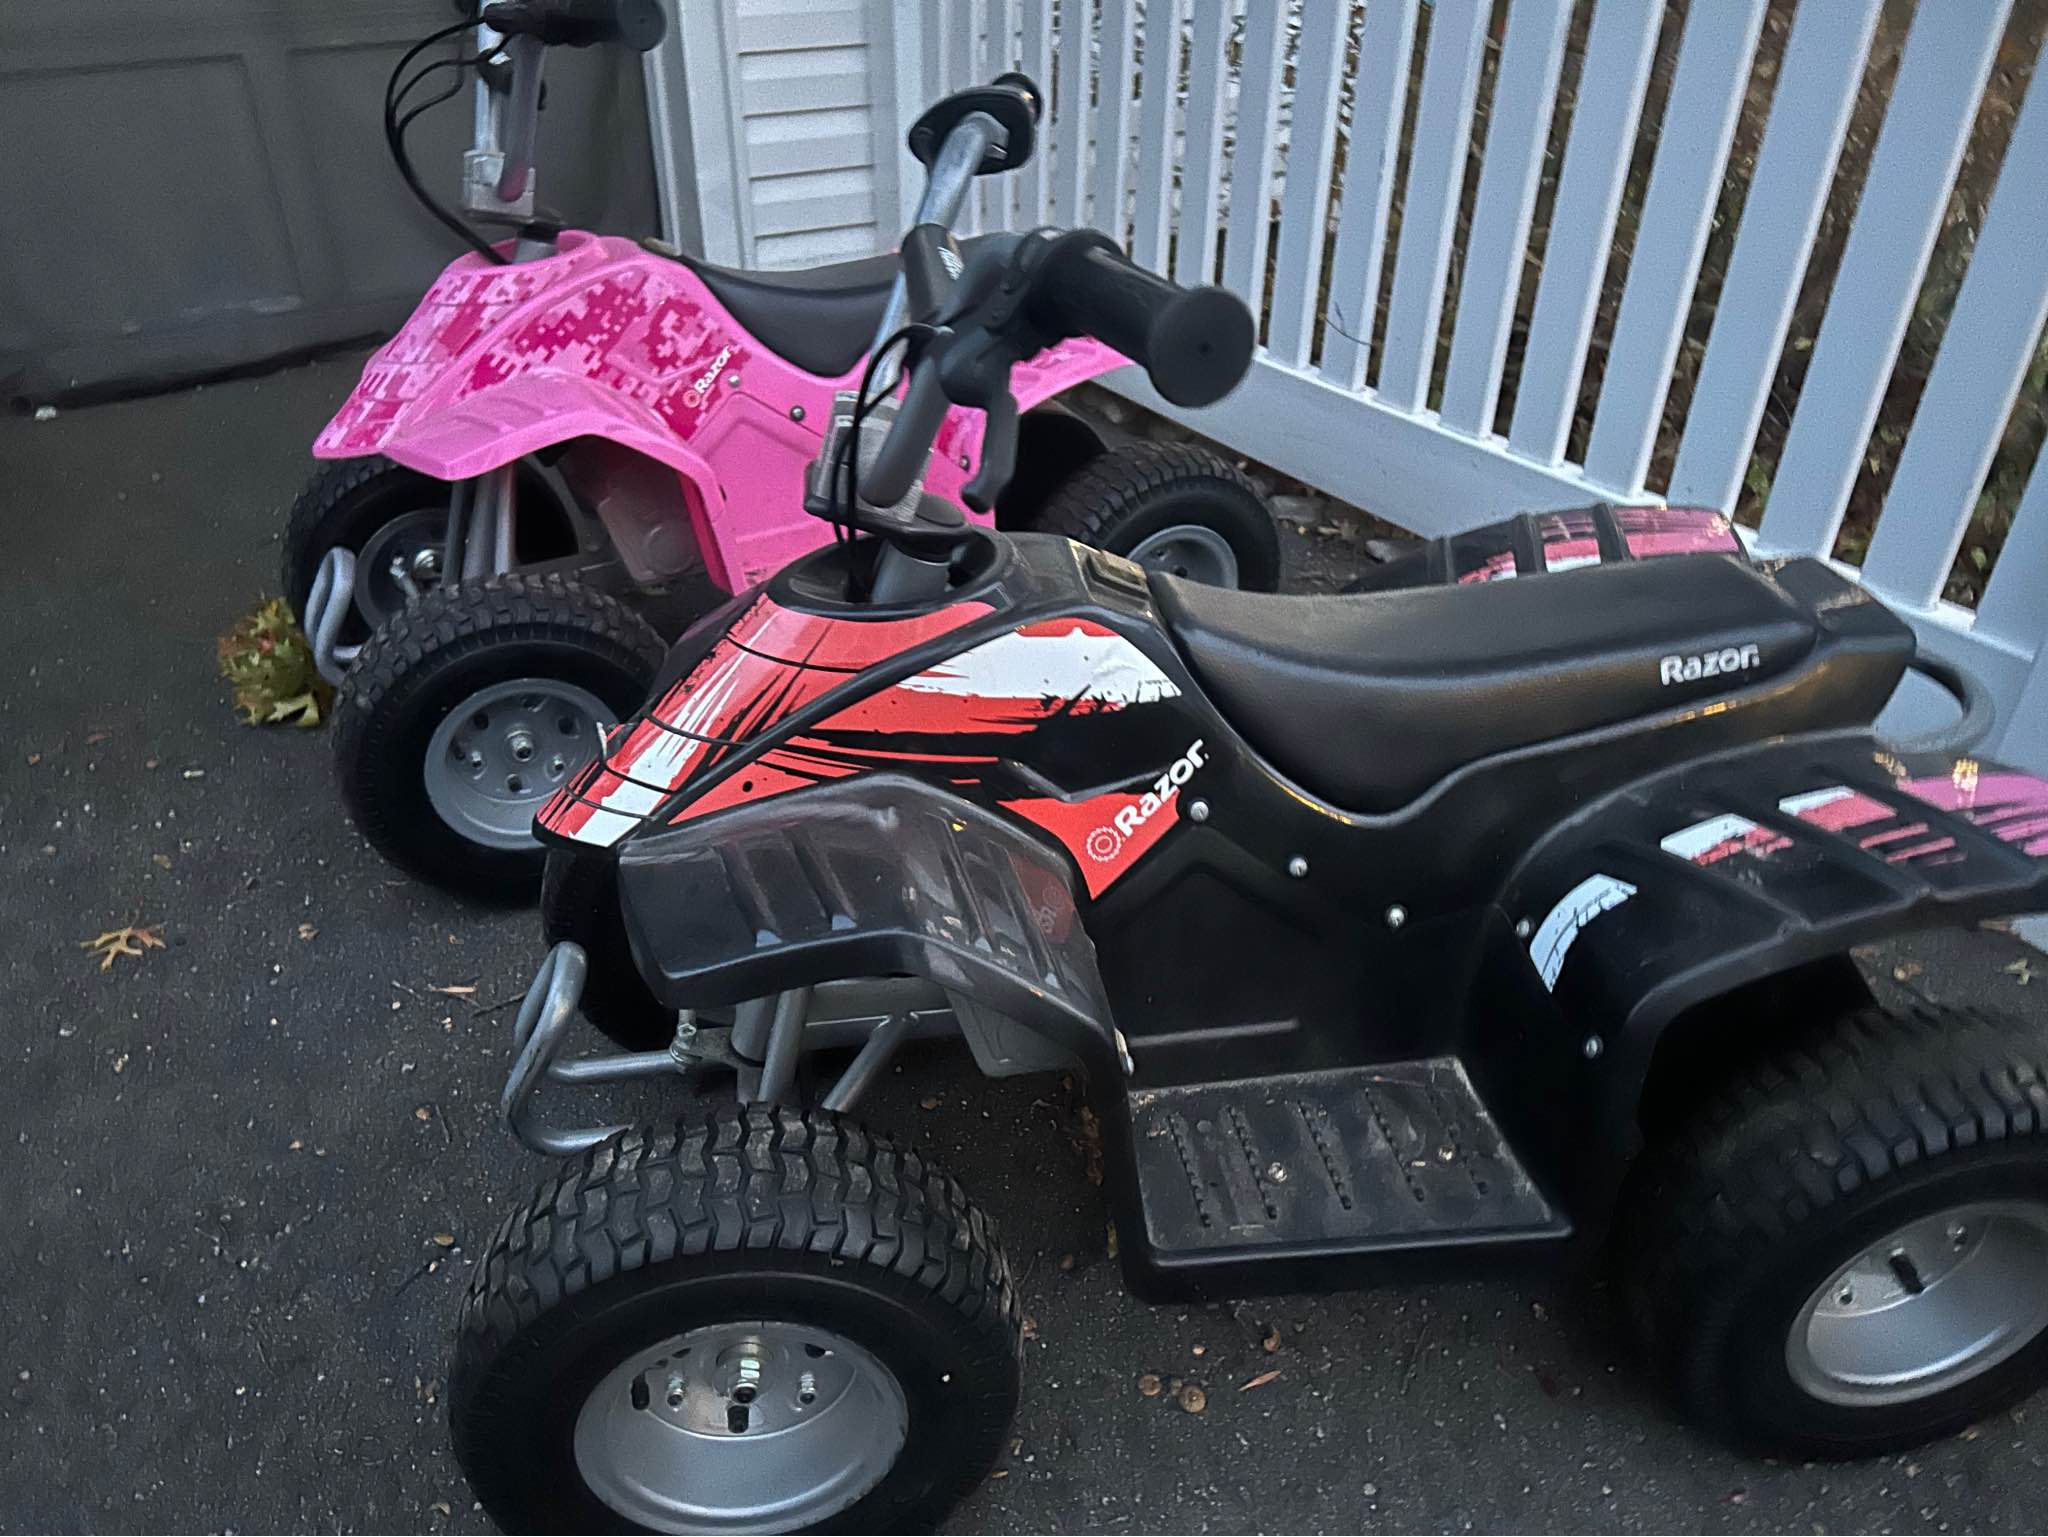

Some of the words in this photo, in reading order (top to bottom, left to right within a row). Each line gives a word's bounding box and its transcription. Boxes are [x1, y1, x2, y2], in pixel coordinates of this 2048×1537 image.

[694, 345, 731, 394] Razor
[1660, 644, 1760, 686] Razor
[1114, 739, 1207, 837] Razor
